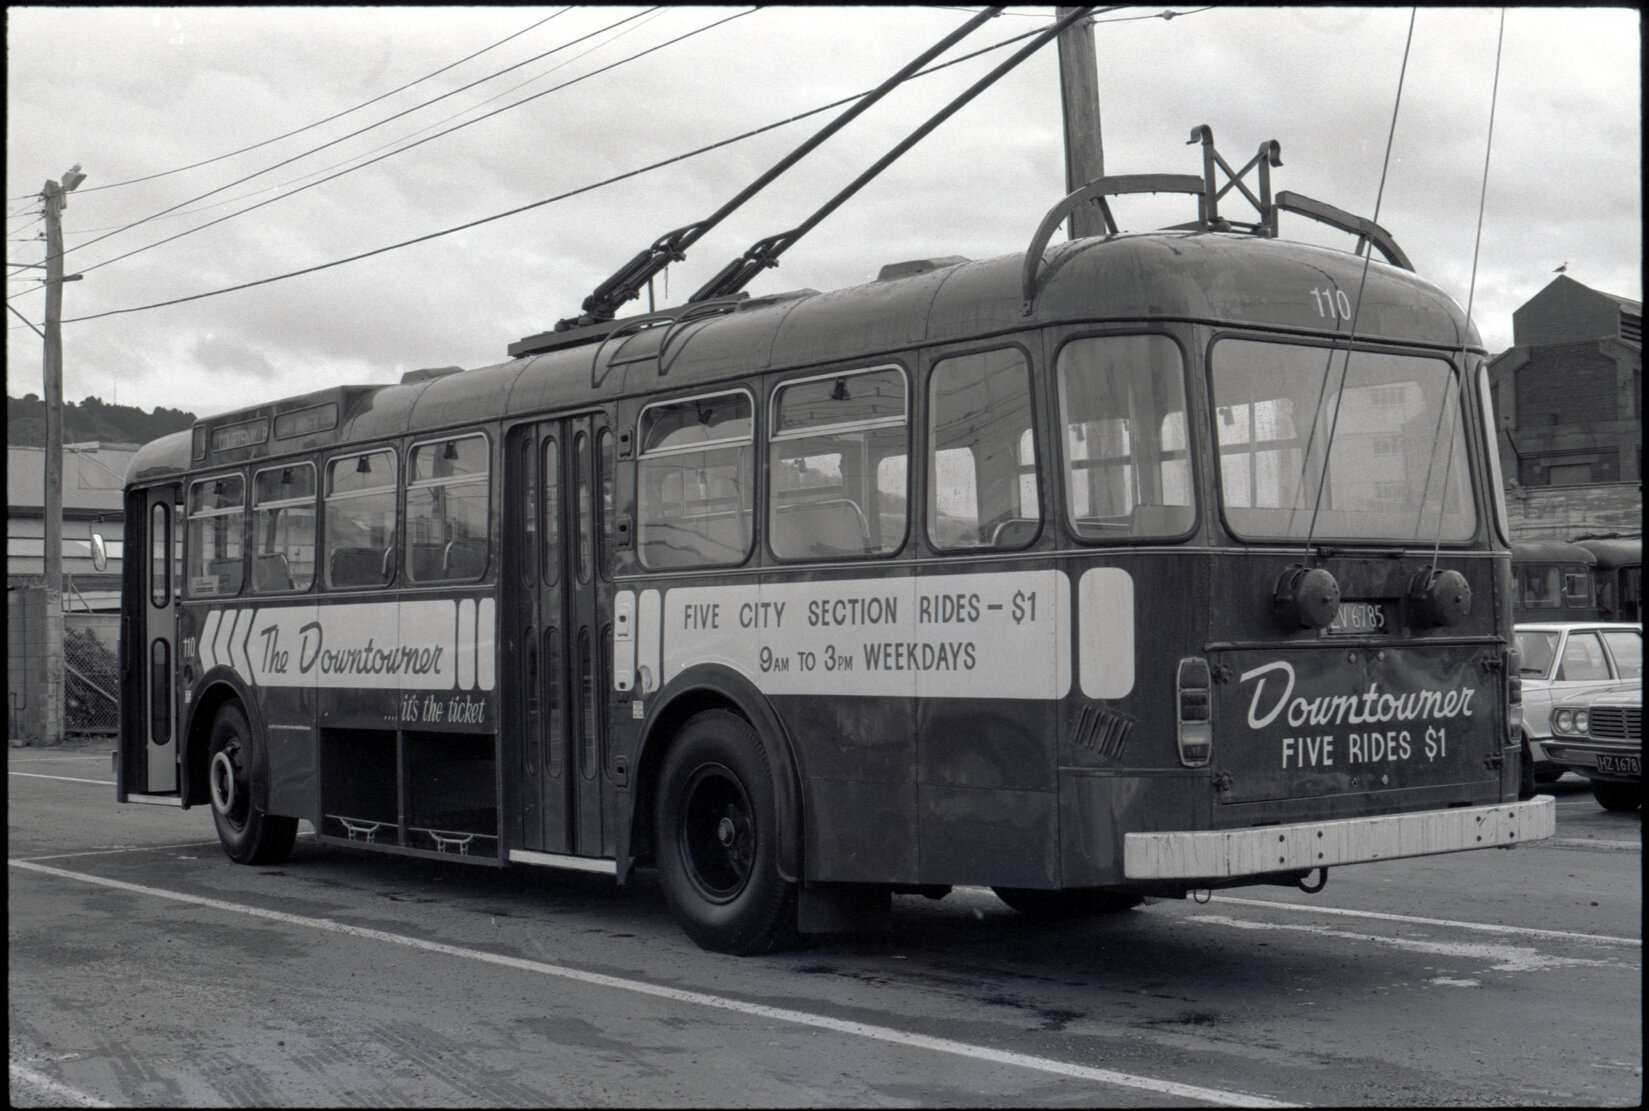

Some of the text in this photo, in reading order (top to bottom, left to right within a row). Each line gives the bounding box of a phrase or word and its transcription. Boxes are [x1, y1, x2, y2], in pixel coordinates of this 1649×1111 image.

[1310, 287, 1351, 320] 110
[684, 602, 719, 630] FIVE
[739, 602, 785, 628] CITY
[808, 597, 898, 626] SECTION
[919, 594, 980, 624] RIDES
[1011, 590, 1037, 624] $1
[183, 637, 195, 657] 110
[260, 621, 443, 675] The Downtowner
[759, 642, 976, 672] 9AM TO 3PM WEEKDAYS
[422, 694, 444, 722] the
[447, 695, 486, 723] ticket
[1239, 660, 1475, 729] Downtowner
[1282, 726, 1447, 769] FIVE RIDES $1
